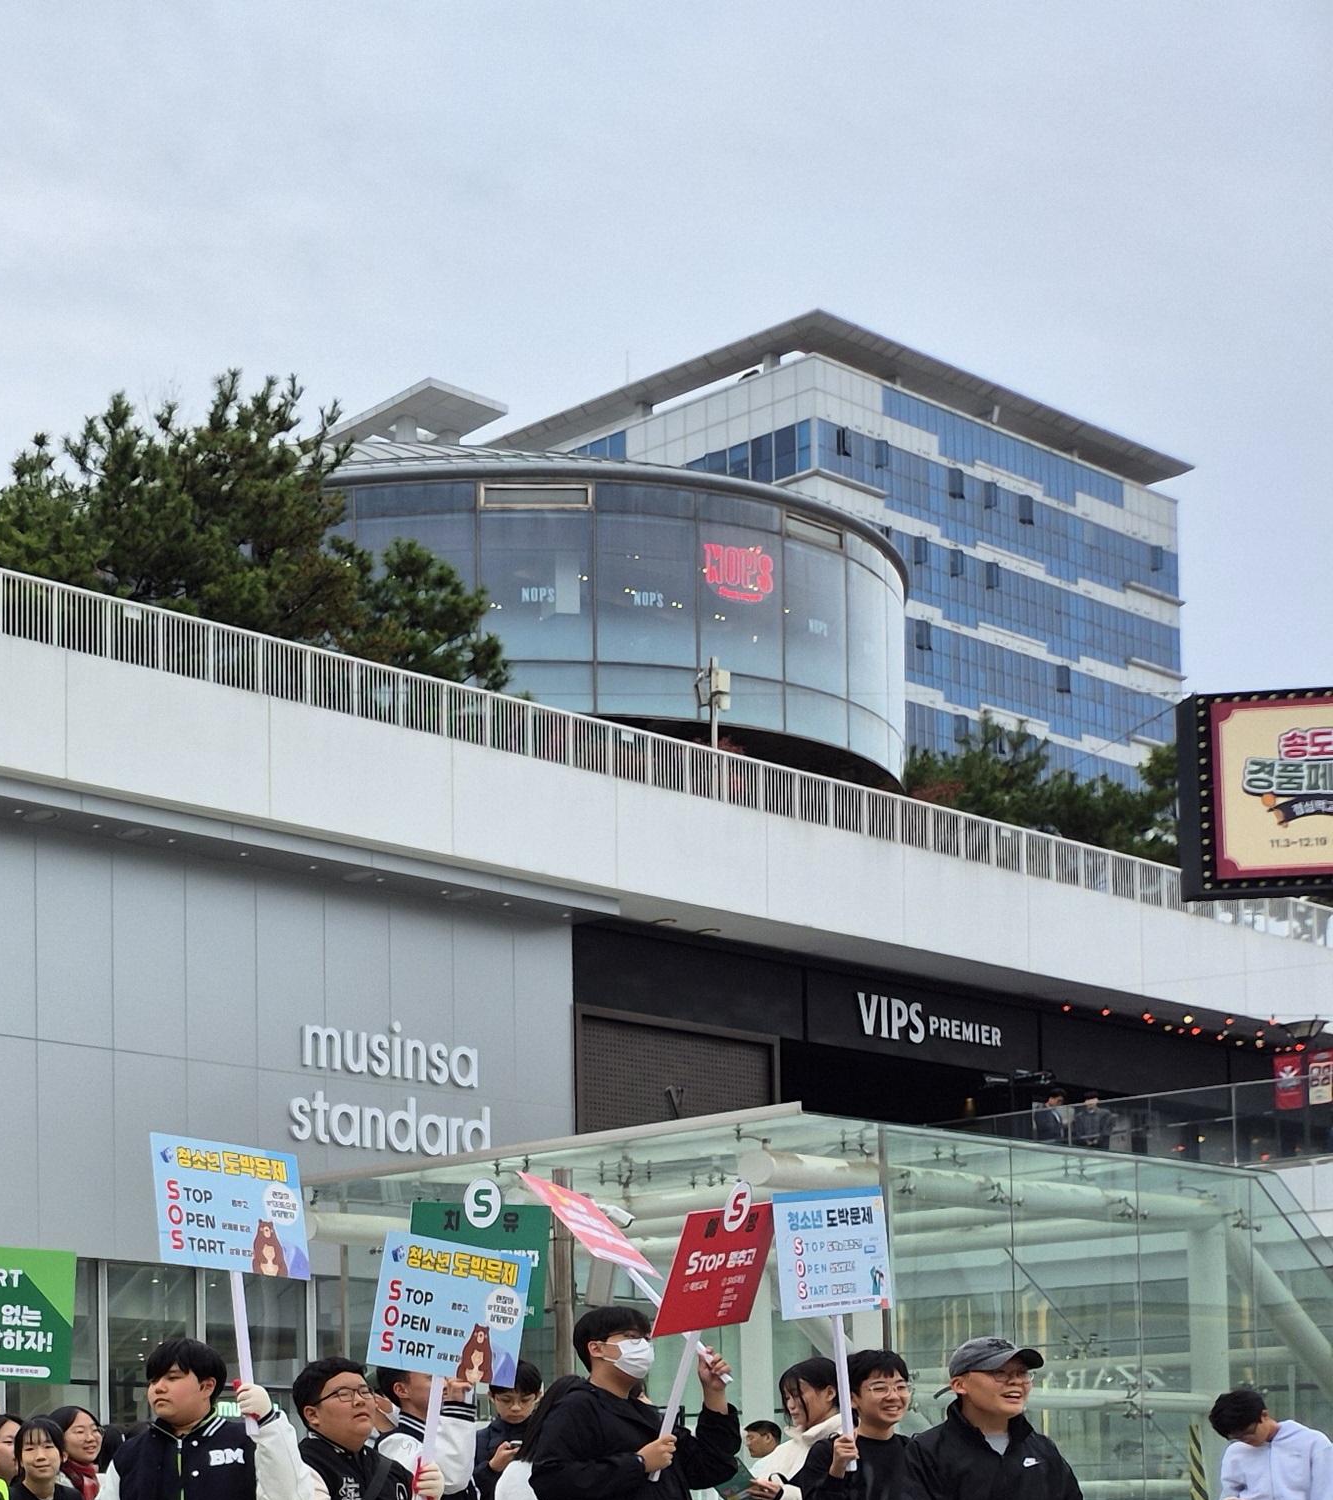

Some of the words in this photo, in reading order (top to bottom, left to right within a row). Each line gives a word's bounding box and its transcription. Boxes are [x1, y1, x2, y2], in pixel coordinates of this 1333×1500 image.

[857, 991, 925, 1044] VIPS
[929, 1015, 1002, 1047] PREMIER
[301, 1020, 479, 1088] musinsa
[289, 1090, 492, 1156] standard
[176, 1146, 222, 1172] 청소년
[222, 1150, 289, 1183] 도박문제
[444, 1210, 461, 1232] 치
[473, 1189, 492, 1218] S
[502, 1212, 520, 1233] 유
[728, 1191, 747, 1223] S
[787, 1209, 824, 1232] 청소년
[826, 1206, 874, 1228] 도박문제
[407, 1245, 452, 1274] 청소년
[452, 1252, 520, 1287] 도박문제
[685, 1250, 726, 1276] STOP
[1, 1304, 43, 1328] 없는
[208, 1447, 245, 1467] BM
